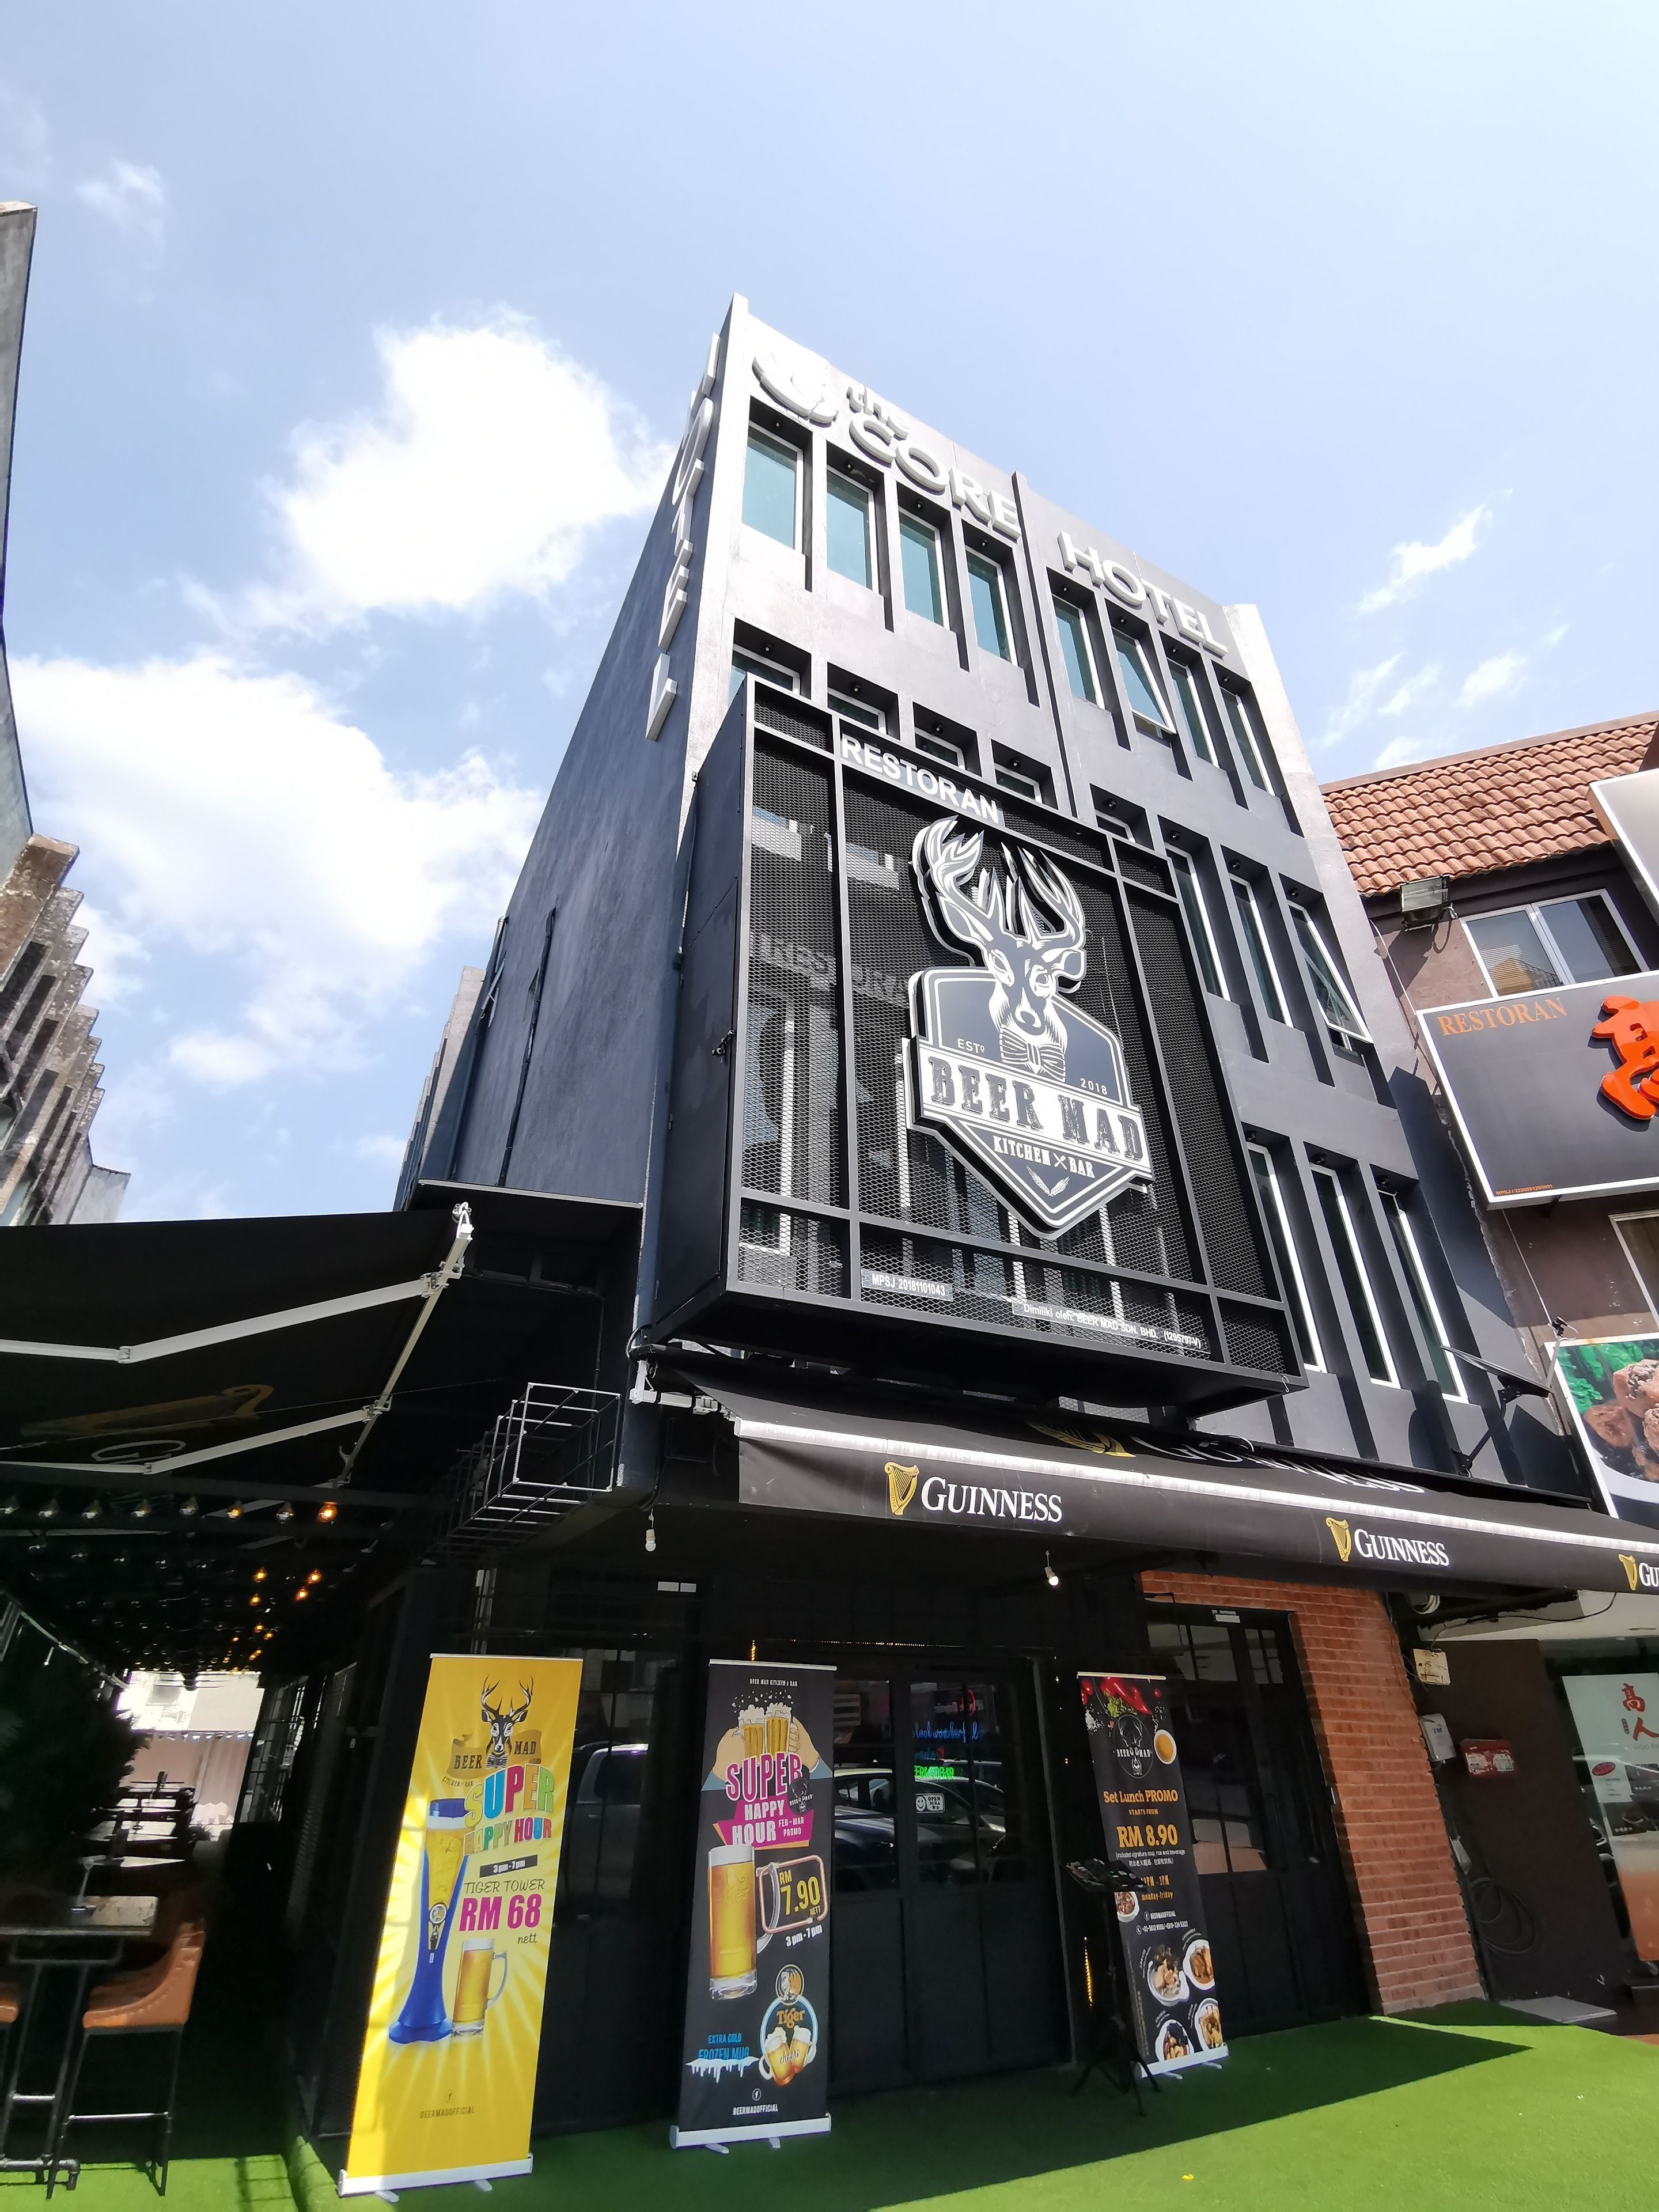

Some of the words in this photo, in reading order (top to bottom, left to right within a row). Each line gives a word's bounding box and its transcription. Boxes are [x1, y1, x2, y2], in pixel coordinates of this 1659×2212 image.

[849, 414, 1022, 541] CORE
[1057, 530, 1228, 661] HOTEL
[841, 733, 1000, 824] RESTORAN
[1436, 997, 1567, 1036] RESTORAN
[1080, 1077, 1108, 1096] 2018
[928, 1056, 1044, 1131] BEER
[1058, 1094, 1144, 1161] MAD
[992, 1135, 1051, 1166] KITCHEN
[1069, 1160, 1096, 1179] BAR
[872, 1274, 895, 1287] MPSJ
[898, 1278, 946, 1296] 20181101043
[1023, 1303, 1053, 1318] Dimiliki
[1077, 1313, 1098, 1327] BEER
[1100, 1317, 1119, 1331] MAD
[922, 1476, 1063, 1522] GUINNESS
[1354, 1529, 1450, 1566] GUINNESS
[454, 1755, 482, 1769] BEER
[514, 1741, 536, 1755] MAD
[725, 1752, 803, 1802] SUPER
[464, 1763, 554, 1828] SUPER
[1103, 1791, 1119, 1803] Set
[1119, 1790, 1145, 1803] Lunch
[1145, 1789, 1179, 1802] PROMO
[745, 1800, 785, 1821] HAPPY
[464, 1820, 513, 1856] HAPPY
[514, 1817, 552, 1844] HOUR
[732, 1820, 777, 1844] HOUR
[783, 1828, 802, 1836] PROMO
[1116, 1825, 1144, 1848] RM
[1146, 1824, 1178, 1846] 8.90
[464, 1881, 500, 1894] TIGER
[503, 1878, 545, 1892] TOWER
[779, 1870, 792, 1885] RM
[781, 1876, 820, 1915] 7.90
[459, 1896, 503, 1931] RM
[507, 1893, 542, 1929] 68
[517, 1932, 537, 1944] nett
[777, 2008, 805, 2028] Tiger
[708, 2034, 726, 2044] EXTRA
